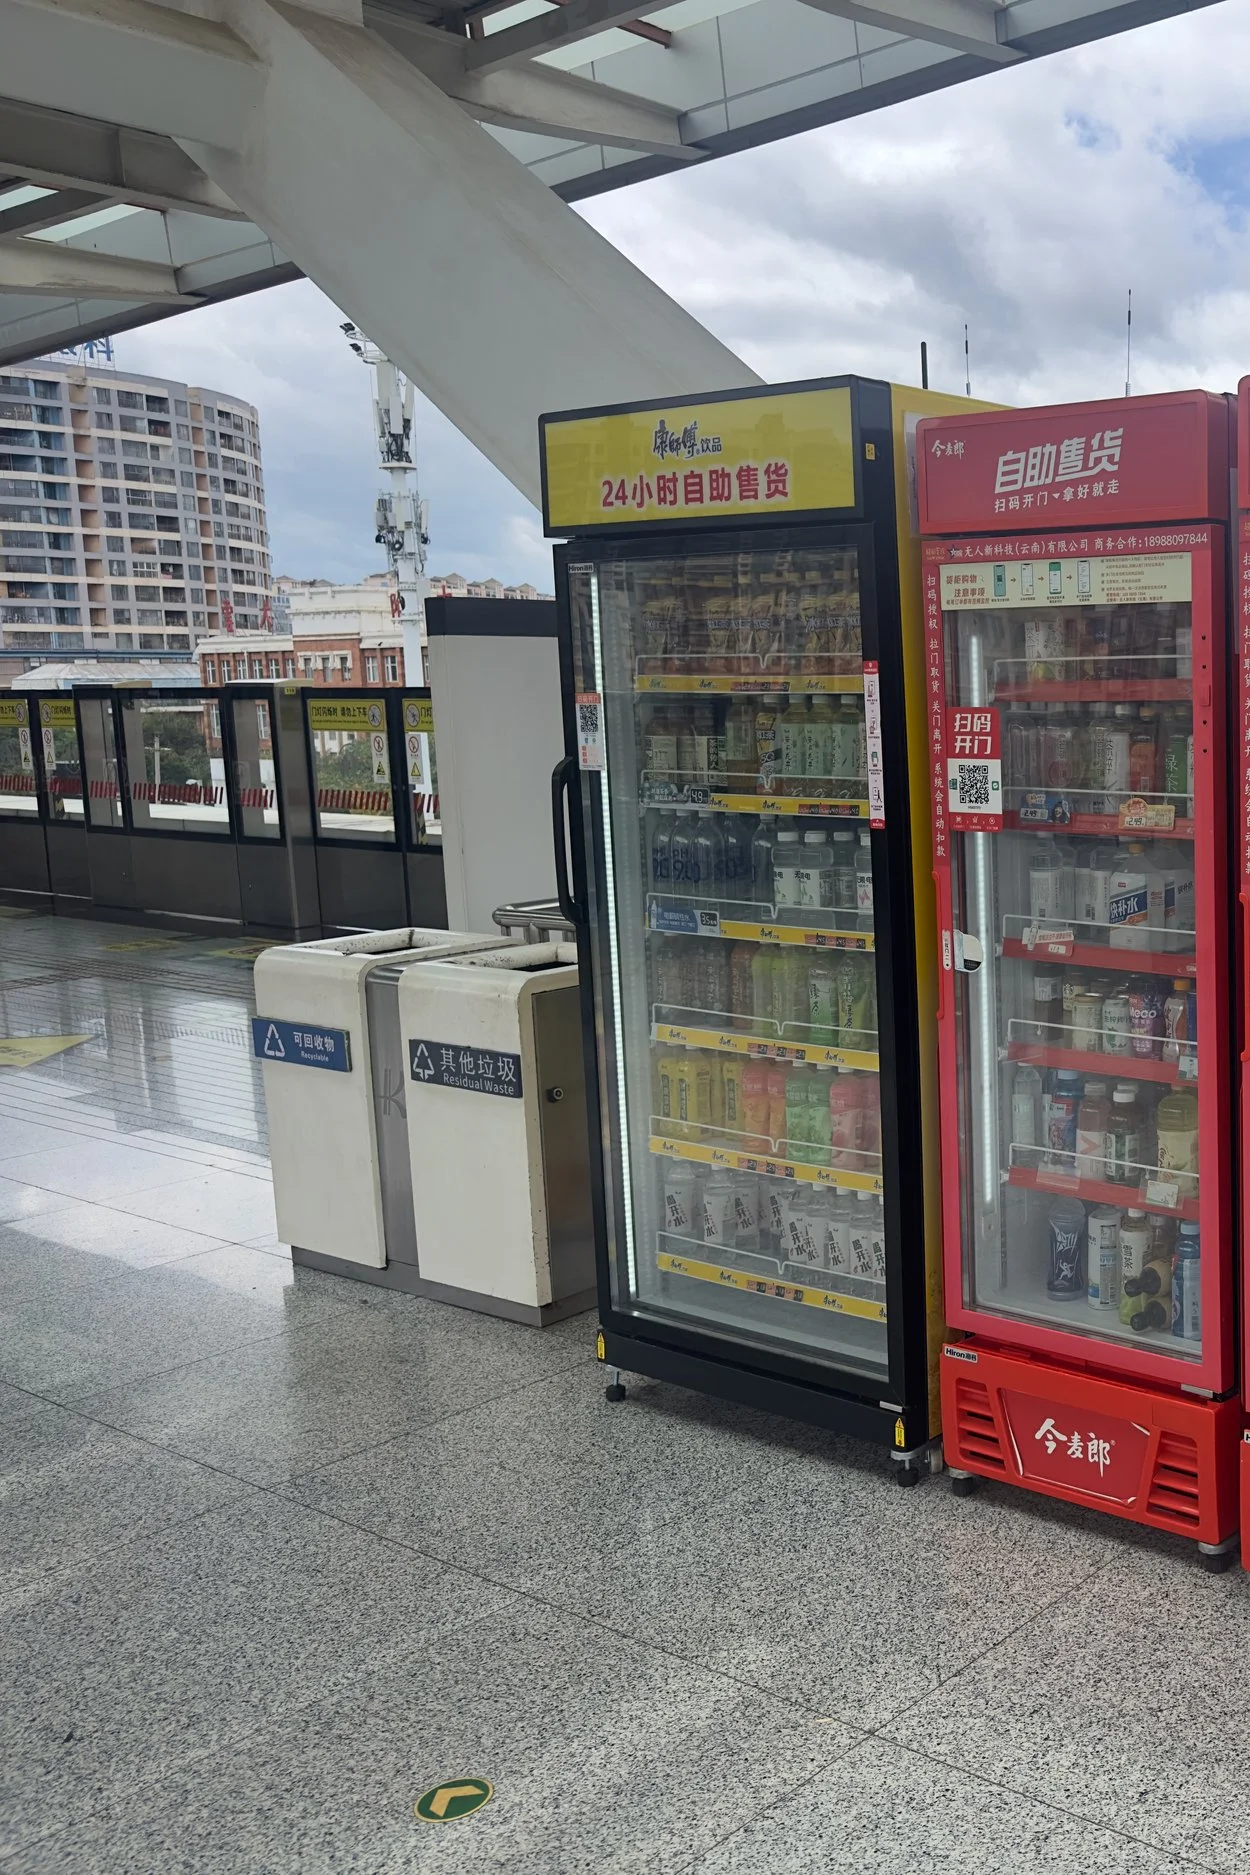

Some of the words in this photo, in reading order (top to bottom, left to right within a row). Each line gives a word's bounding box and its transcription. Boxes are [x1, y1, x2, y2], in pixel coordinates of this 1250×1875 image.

[931, 439, 966, 461] 今麦郎
[994, 427, 1125, 494] 自助售货
[601, 461, 790, 509] 24小时自助售货
[994, 491, 1049, 514] 扫码开门
[1062, 478, 1120, 502] 拿好就走
[963, 537, 1089, 558] 无人新科技(云南)有限公司
[1094, 532, 1208, 552] 商务合作:18988097844
[927, 574, 939, 630] 扫码授权
[954, 587, 986, 599] 注意事项
[929, 637, 940, 694] 拉门取货
[931, 700, 943, 754] 关门离开
[954, 713, 992, 733] 扫码
[954, 735, 992, 755] 开门
[934, 763, 947, 857] 系统会自动扣款
[293, 1031, 335, 1053] 可回收物
[300, 1050, 330, 1063] Recyclable
[440, 1048, 517, 1083] 其他垃圾
[443, 1072, 484, 1091] Residual
[484, 1079, 515, 1097] Waste
[1034, 1418, 1112, 1478] 今麦郎
